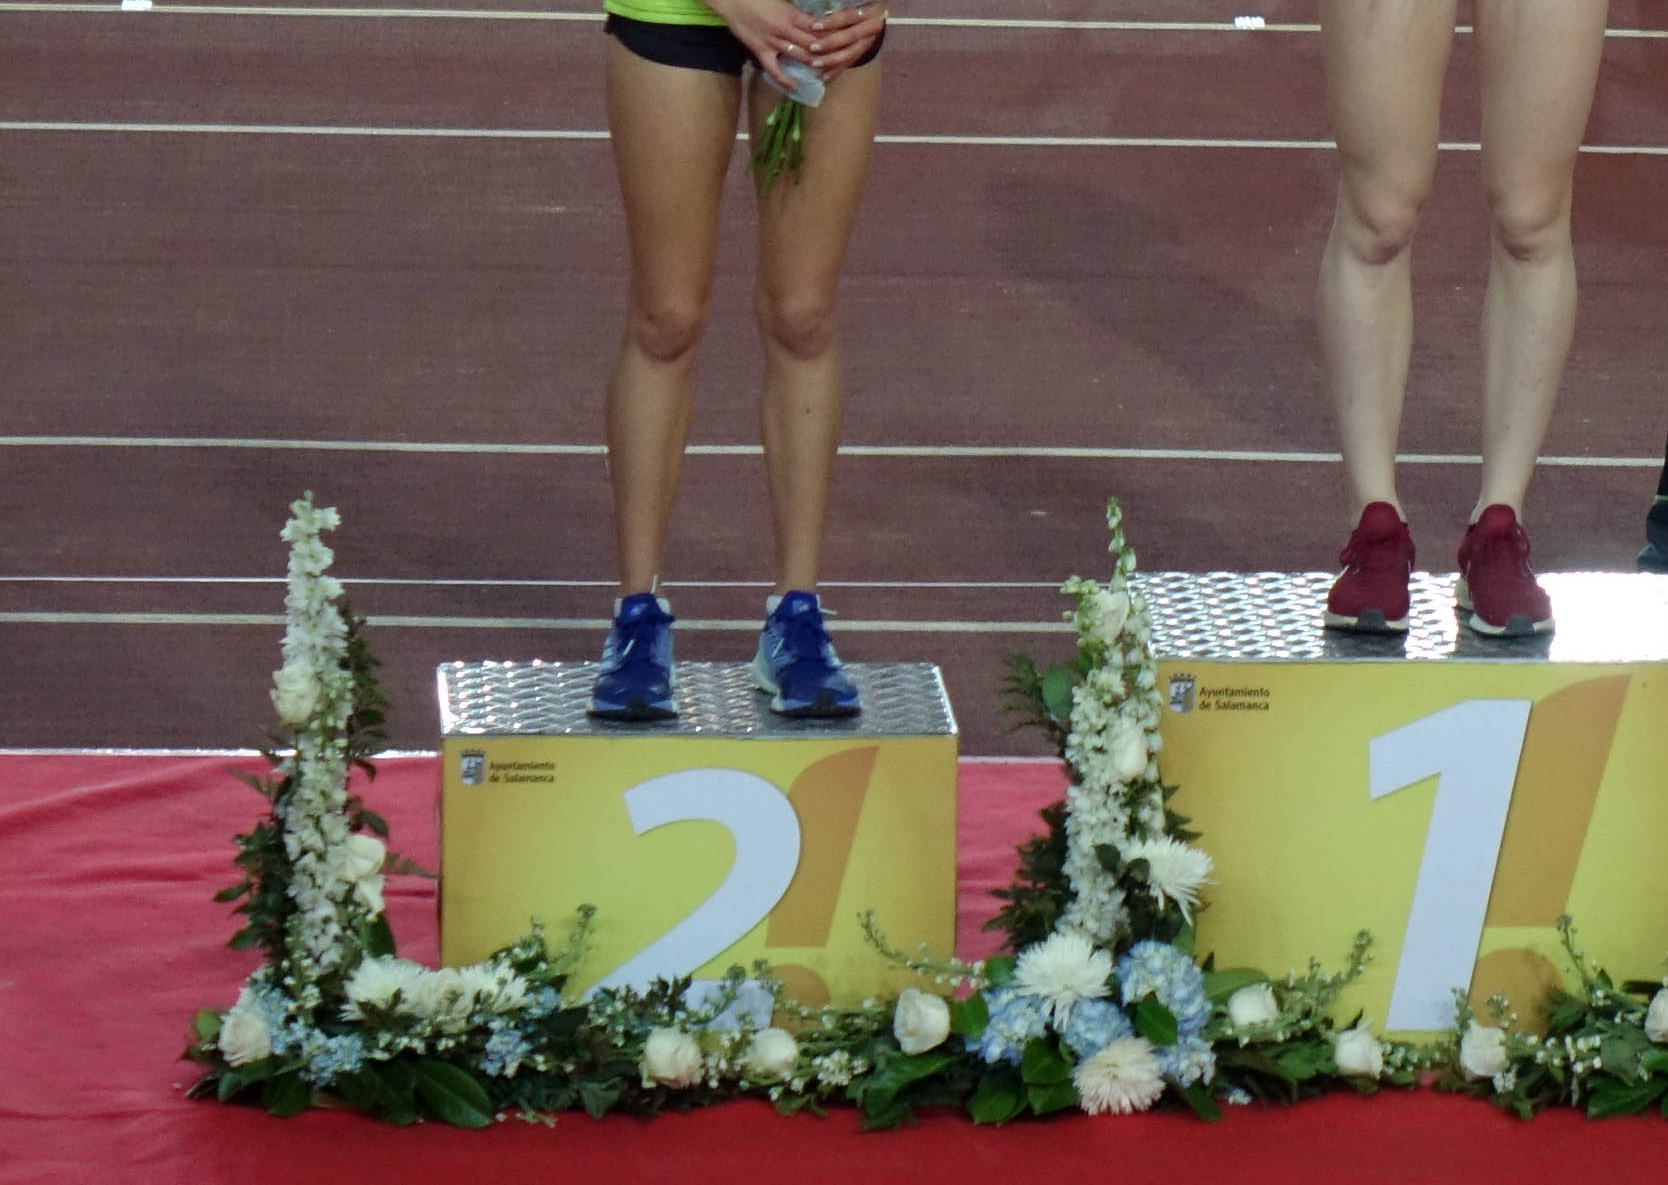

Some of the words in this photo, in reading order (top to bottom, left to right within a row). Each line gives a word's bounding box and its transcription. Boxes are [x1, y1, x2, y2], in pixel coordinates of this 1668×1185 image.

[1200, 687, 1269, 698] Ayuntamiento
[1200, 700, 1210, 710] de
[1216, 700, 1269, 711] Salamanca
